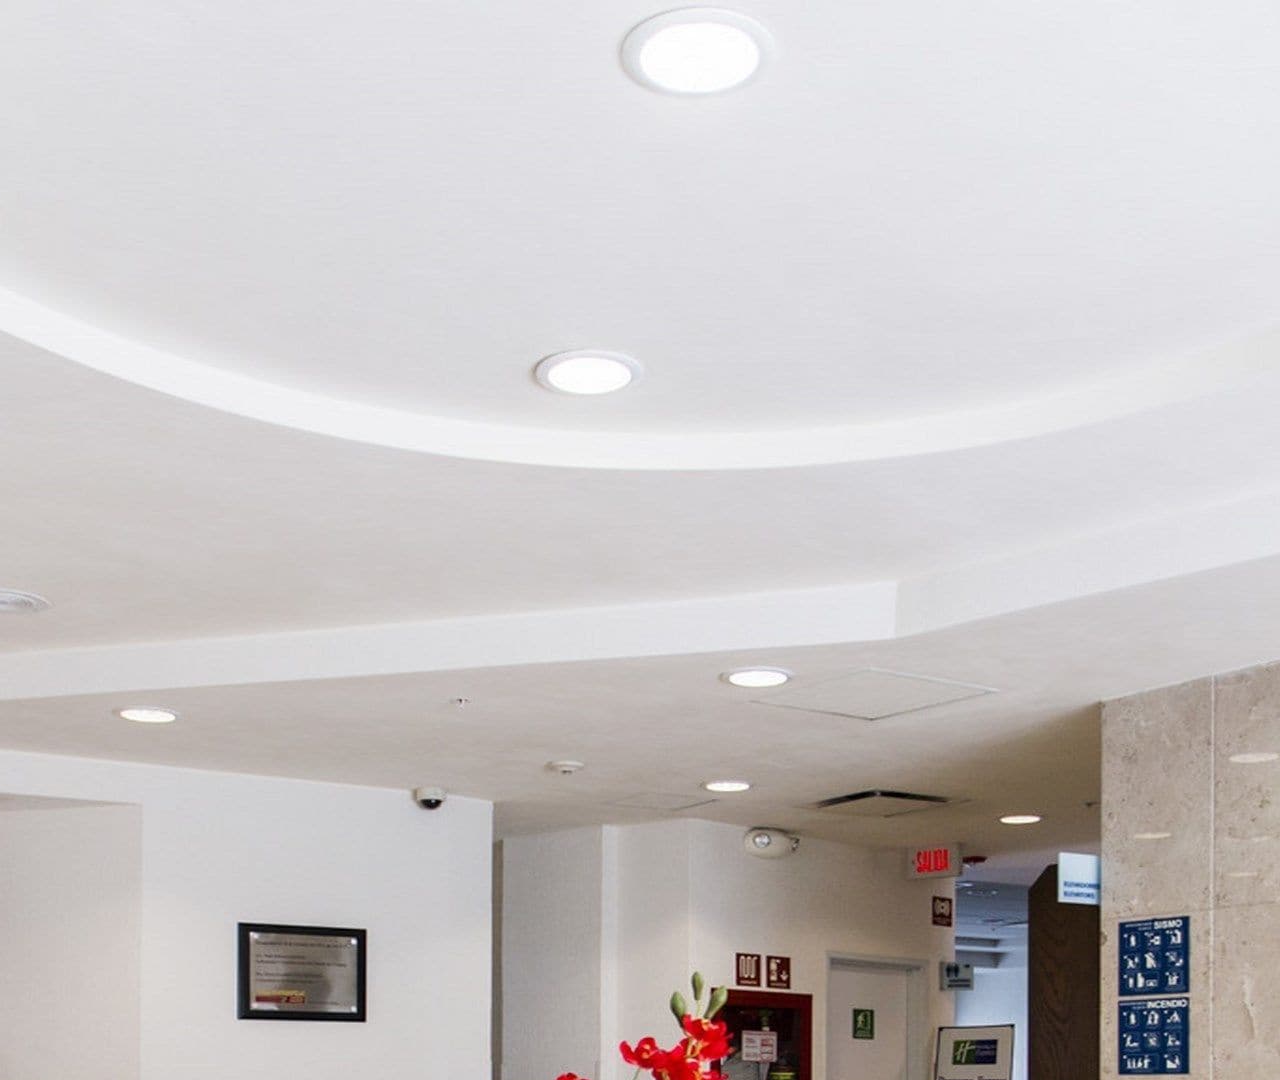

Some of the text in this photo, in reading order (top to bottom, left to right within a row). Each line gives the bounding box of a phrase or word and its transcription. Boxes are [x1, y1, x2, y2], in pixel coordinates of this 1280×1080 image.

[915, 849, 949, 873] SALIDA
[1153, 919, 1183, 930] SISMO
[1146, 999, 1188, 1009] INCENDIO
